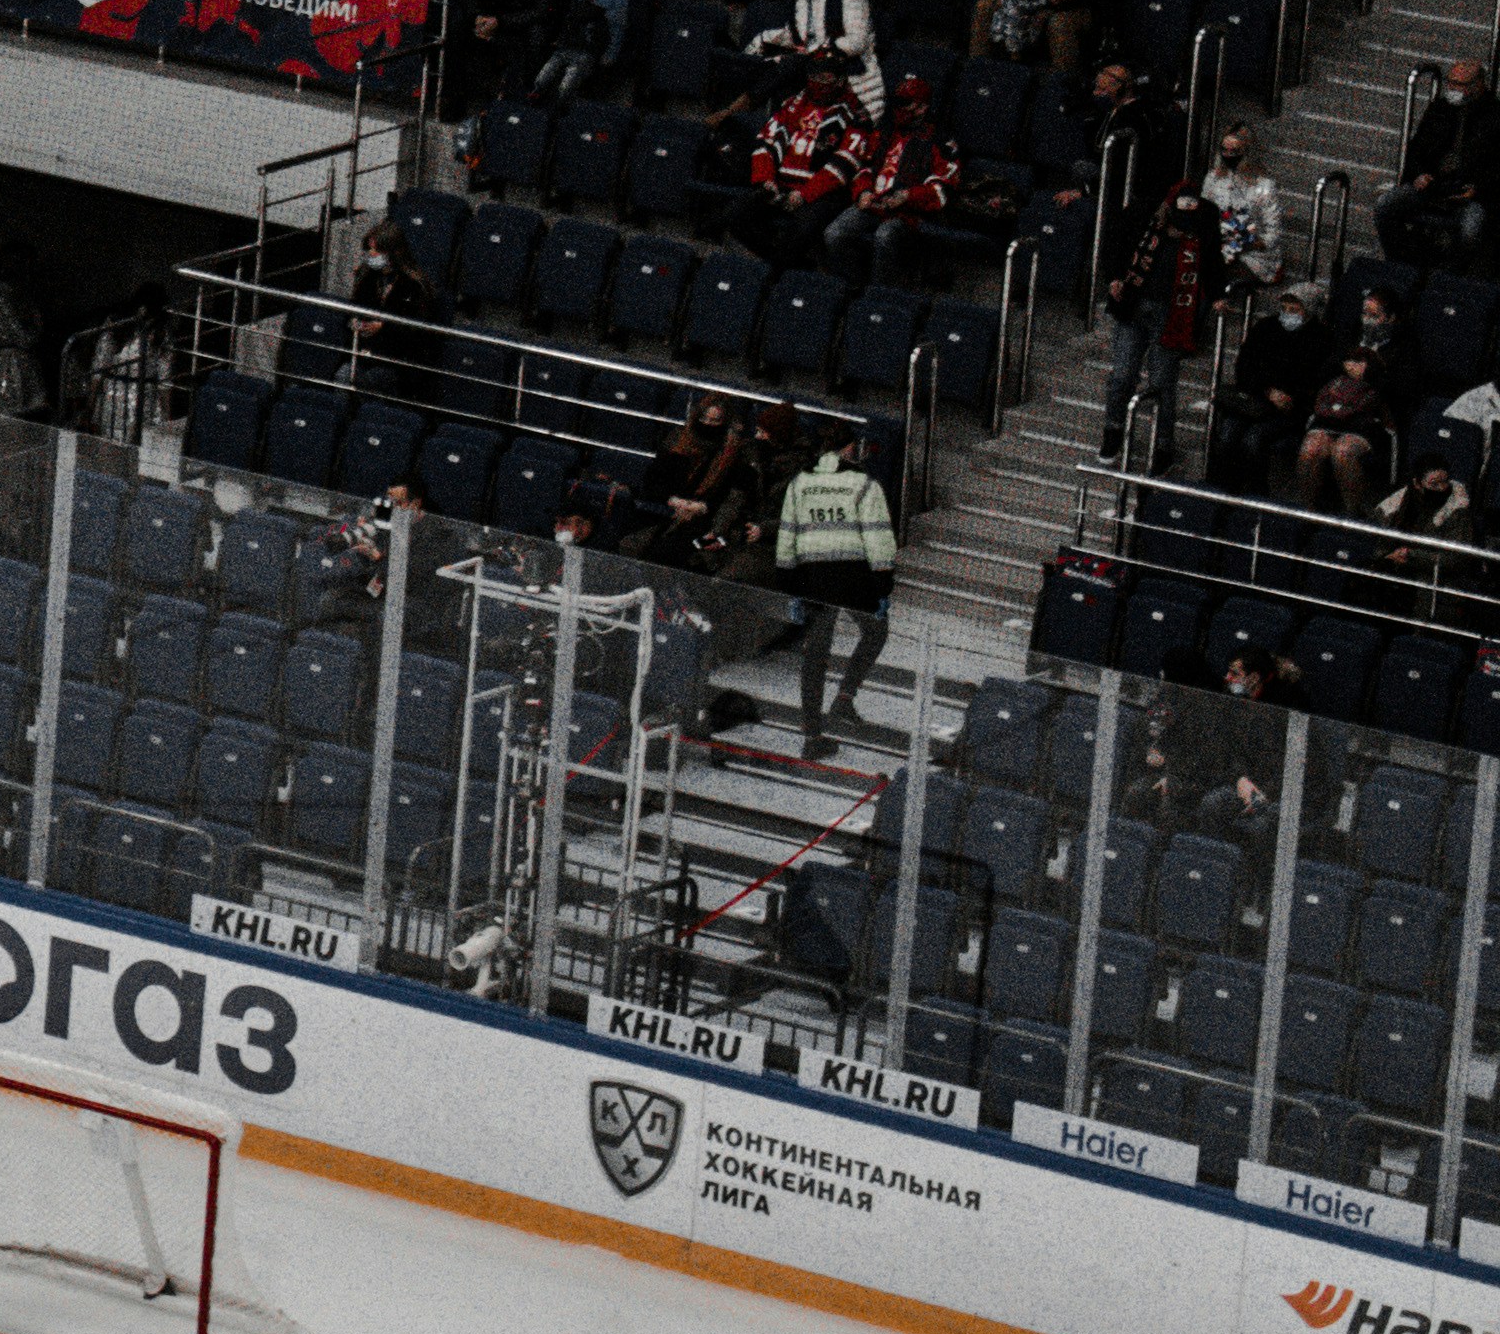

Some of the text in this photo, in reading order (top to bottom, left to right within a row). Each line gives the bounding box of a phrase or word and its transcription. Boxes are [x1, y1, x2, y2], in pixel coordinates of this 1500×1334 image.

[211, 903, 339, 963] KHL.RU
[608, 1004, 742, 1066] KHL.RU
[819, 1058, 959, 1120] KHL.RU
[706, 1121, 982, 1212] КОНТИНЕНТАЛЬНАЯ
[1060, 1121, 1149, 1169] Haier
[701, 1181, 772, 1217] ЛИГА
[703, 1150, 874, 1213] ХОККЕЙНАЯ
[1285, 1179, 1376, 1229] Haier
